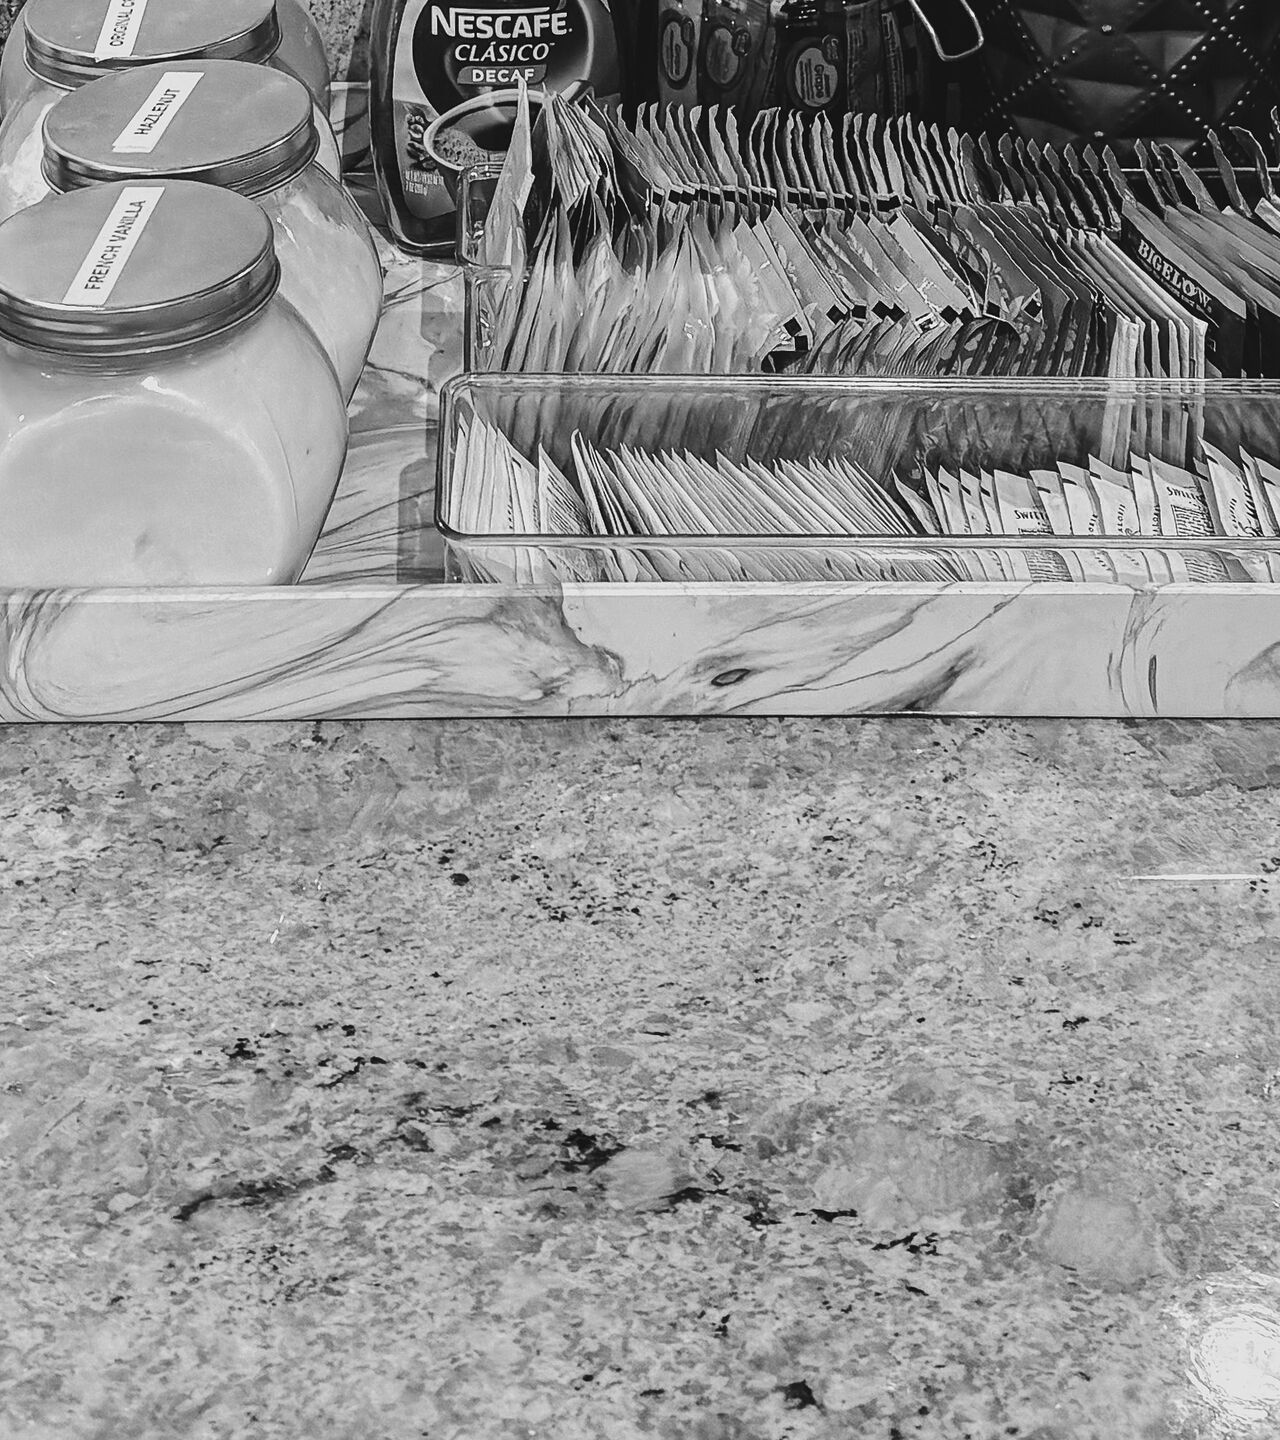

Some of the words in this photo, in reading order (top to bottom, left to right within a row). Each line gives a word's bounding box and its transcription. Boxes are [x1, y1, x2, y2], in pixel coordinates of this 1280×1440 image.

[454, 41, 550, 61] CLÁSICO
[472, 68, 535, 83] DECAF
[84, 245, 122, 290] FRENCH
[109, 200, 146, 242] VANILLA
[1138, 239, 1212, 308] BIGELOW
